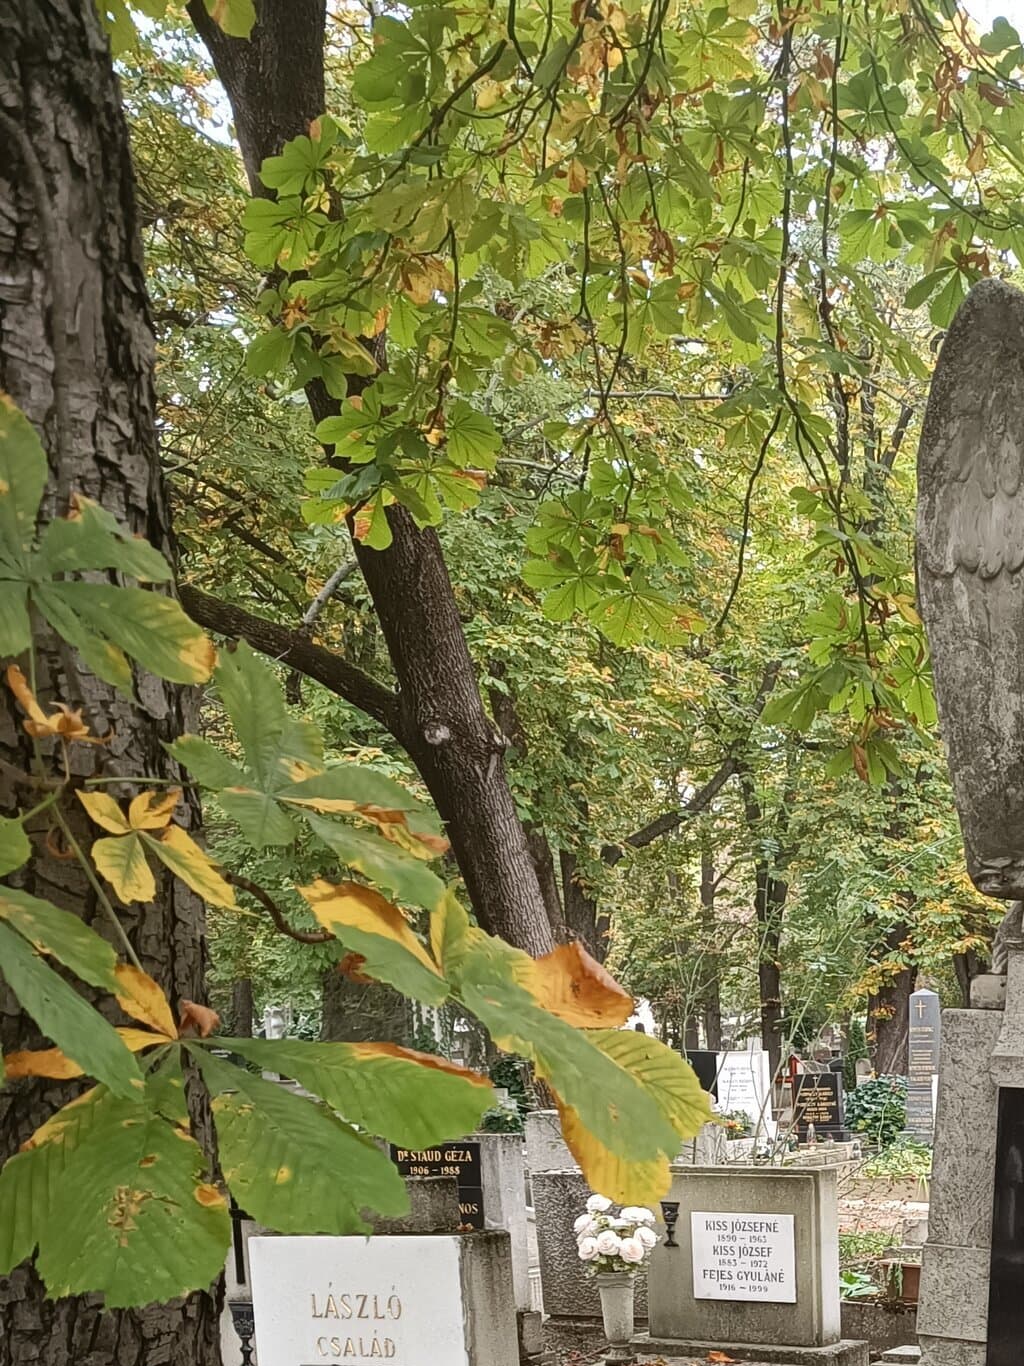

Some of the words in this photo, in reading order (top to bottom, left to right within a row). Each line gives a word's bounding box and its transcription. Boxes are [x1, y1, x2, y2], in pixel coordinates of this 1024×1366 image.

[410, 1150, 441, 1162] STAUD
[444, 1146, 472, 1162] GÉZA
[409, 1166, 430, 1175] 1906
[440, 1166, 460, 1175] 1988
[705, 1220, 728, 1231] KISS
[731, 1218, 779, 1234] JÓZSEFNÉ
[712, 1245, 735, 1256] KISS
[738, 1243, 773, 1259] JÓZSEF
[703, 1269, 733, 1282] FEJES
[736, 1268, 785, 1283] GYULÁNÉ
[310, 1281, 402, 1320] LÁSZLÓ
[317, 1329, 396, 1358] CSALÁD
